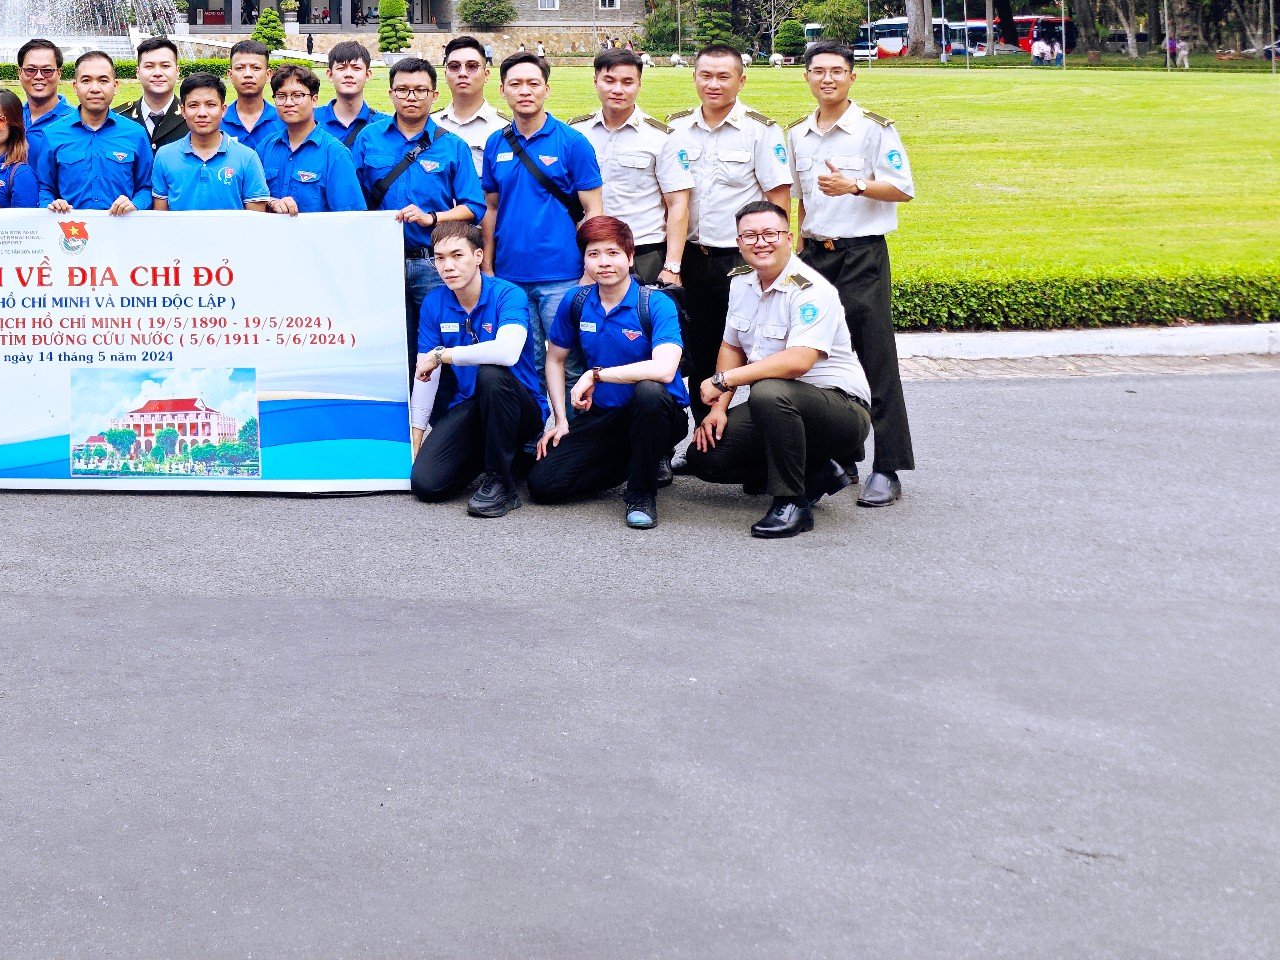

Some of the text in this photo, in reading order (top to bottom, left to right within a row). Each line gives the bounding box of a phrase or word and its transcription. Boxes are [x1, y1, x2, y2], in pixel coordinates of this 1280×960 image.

[13, 256, 54, 287] VỀ
[67, 266, 119, 292] ĐỊA
[130, 259, 181, 287] CHỈ
[193, 258, 234, 287] ĐỎ
[21, 294, 47, 308] CHÍ
[51, 297, 90, 308] MINH
[95, 293, 115, 308] VÀ
[120, 297, 157, 308] DINH
[162, 294, 193, 311] ĐỘC
[198, 294, 226, 311] LẬP
[31, 312, 54, 329] HỒ
[60, 314, 86, 329] CHÍ
[92, 318, 132, 329] MINH
[148, 317, 227, 329] 19/5/1890
[244, 317, 322, 329] 19/5/2024
[0, 331, 26, 346] TÌM
[32, 330, 87, 346] ĐƯỜNG
[93, 330, 126, 345] CỨU
[131, 330, 174, 345] NƯỚC
[190, 333, 260, 346] 5/6/1911
[277, 334, 346, 346] 5/6/2024
[4, 350, 33, 365] ngày
[39, 351, 54, 362] 14
[58, 350, 94, 365] tháng
[99, 351, 106, 362] 5
[111, 351, 137, 362] năm
[142, 351, 174, 362] 2024
